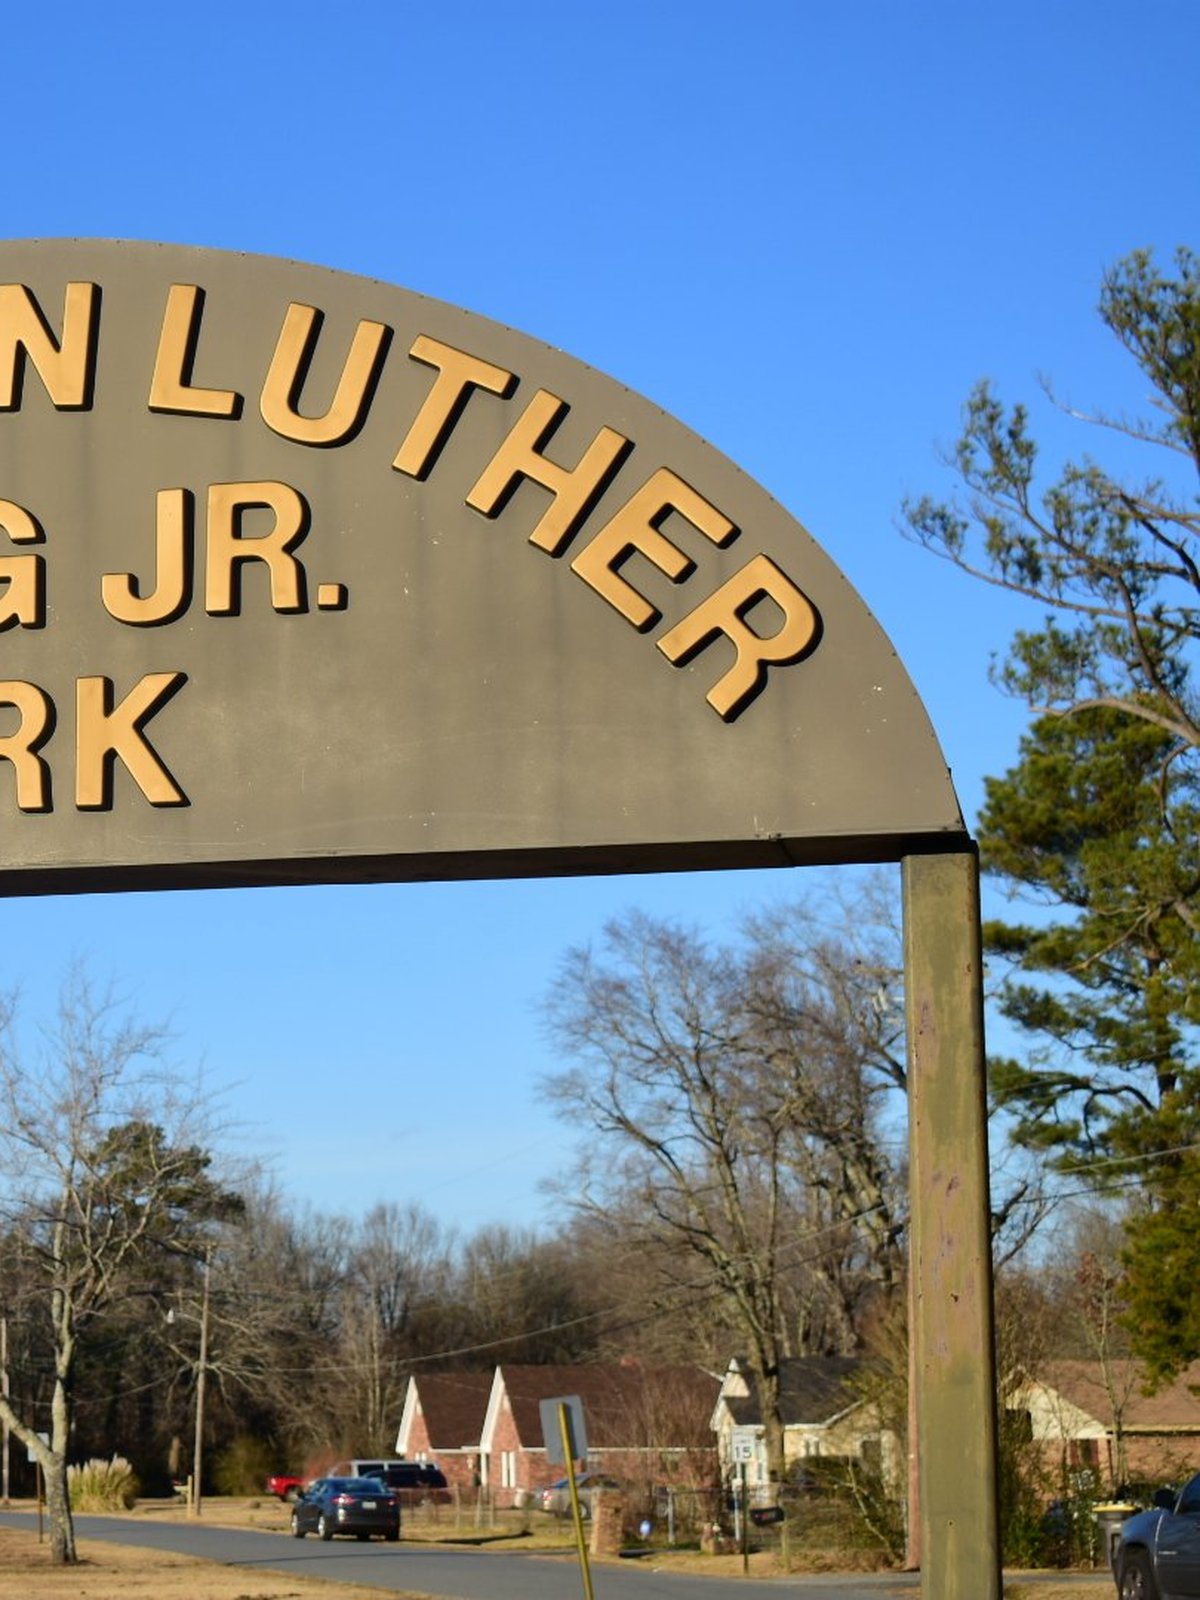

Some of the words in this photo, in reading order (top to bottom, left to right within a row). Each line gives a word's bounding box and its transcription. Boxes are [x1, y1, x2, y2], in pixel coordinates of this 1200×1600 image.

[101, 480, 348, 627] JR.
[148, 283, 823, 723] LUTHER
[735, 1445, 752, 1459] 15
